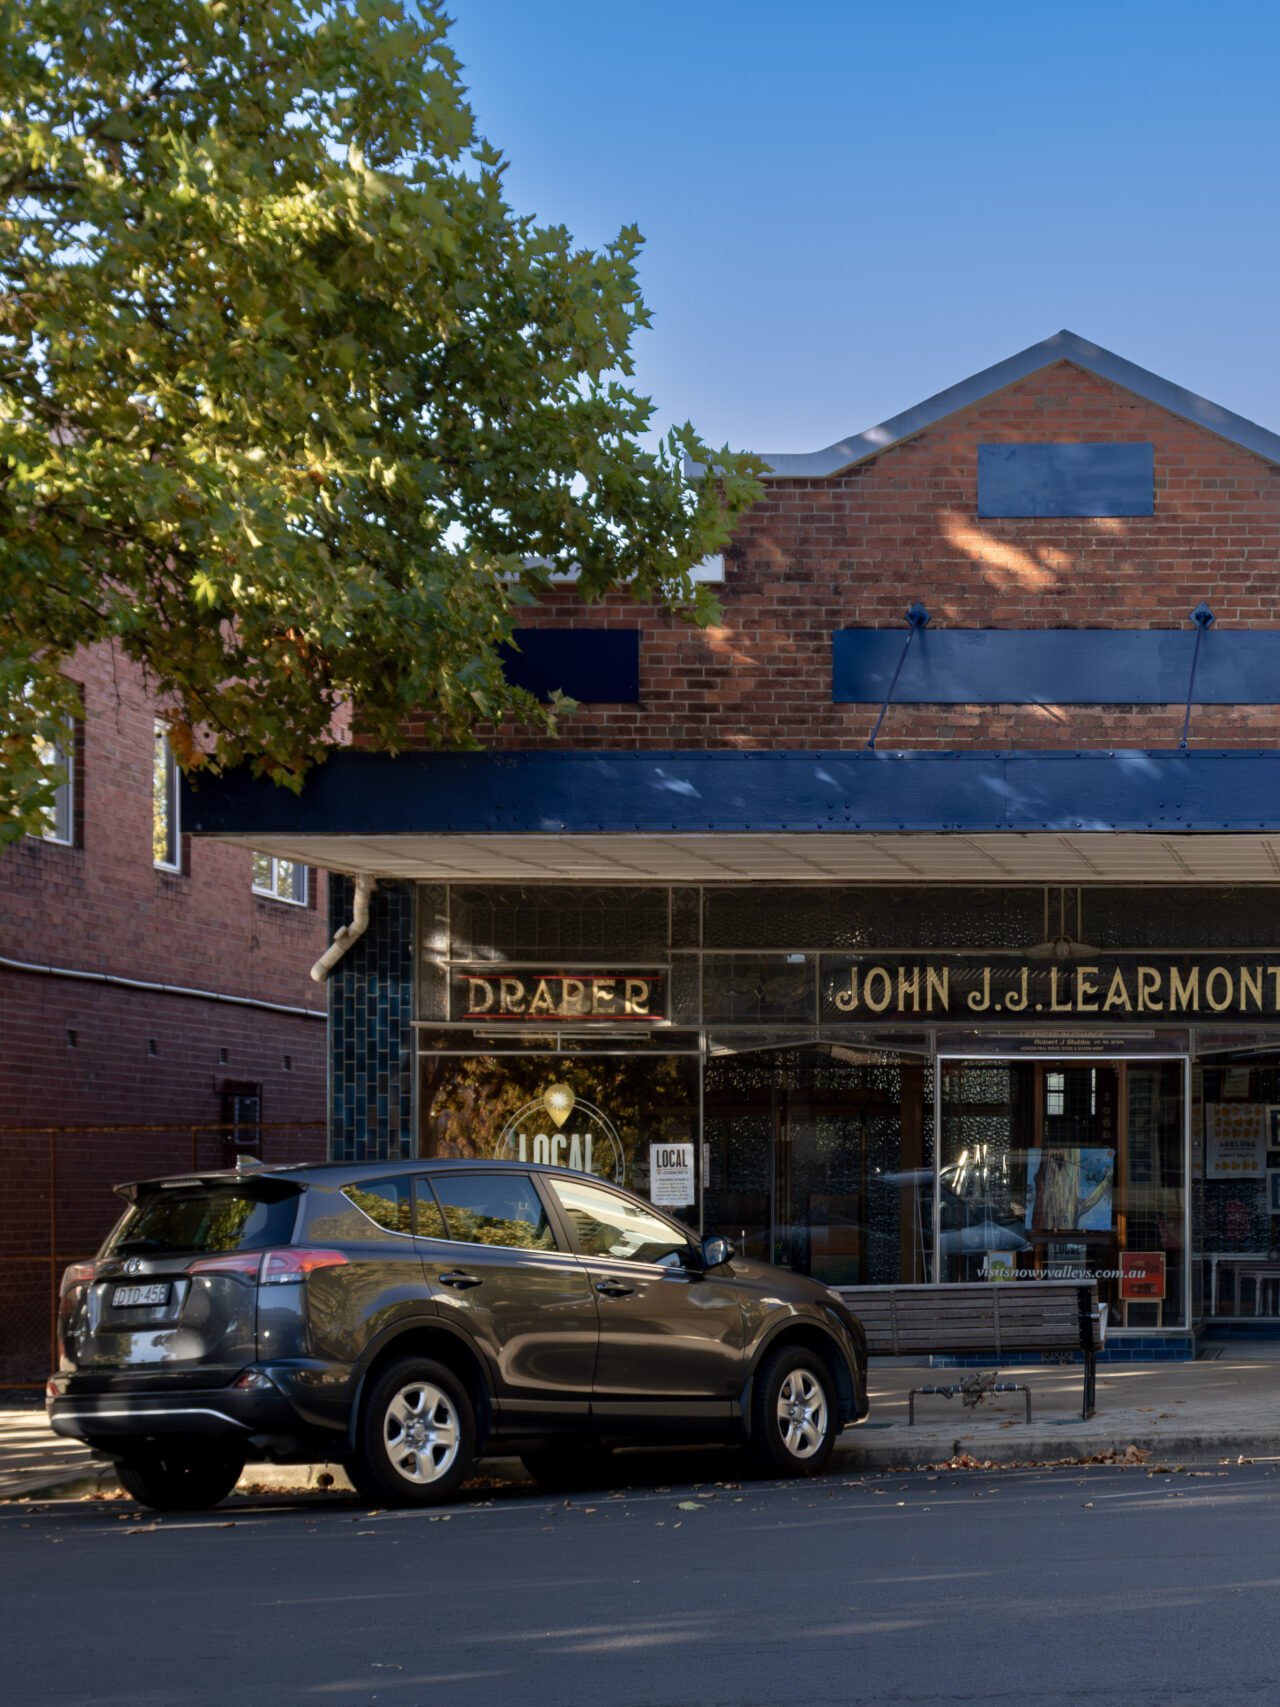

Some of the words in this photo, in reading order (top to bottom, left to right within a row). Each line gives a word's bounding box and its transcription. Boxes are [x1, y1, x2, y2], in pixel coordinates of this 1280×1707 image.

[468, 978, 650, 1015] DRAPER
[836, 966, 949, 1012] JOHN
[656, 1149, 688, 1168] LOCAL
[977, 1265, 1147, 1279] visitsnowyvalleys.com.au
